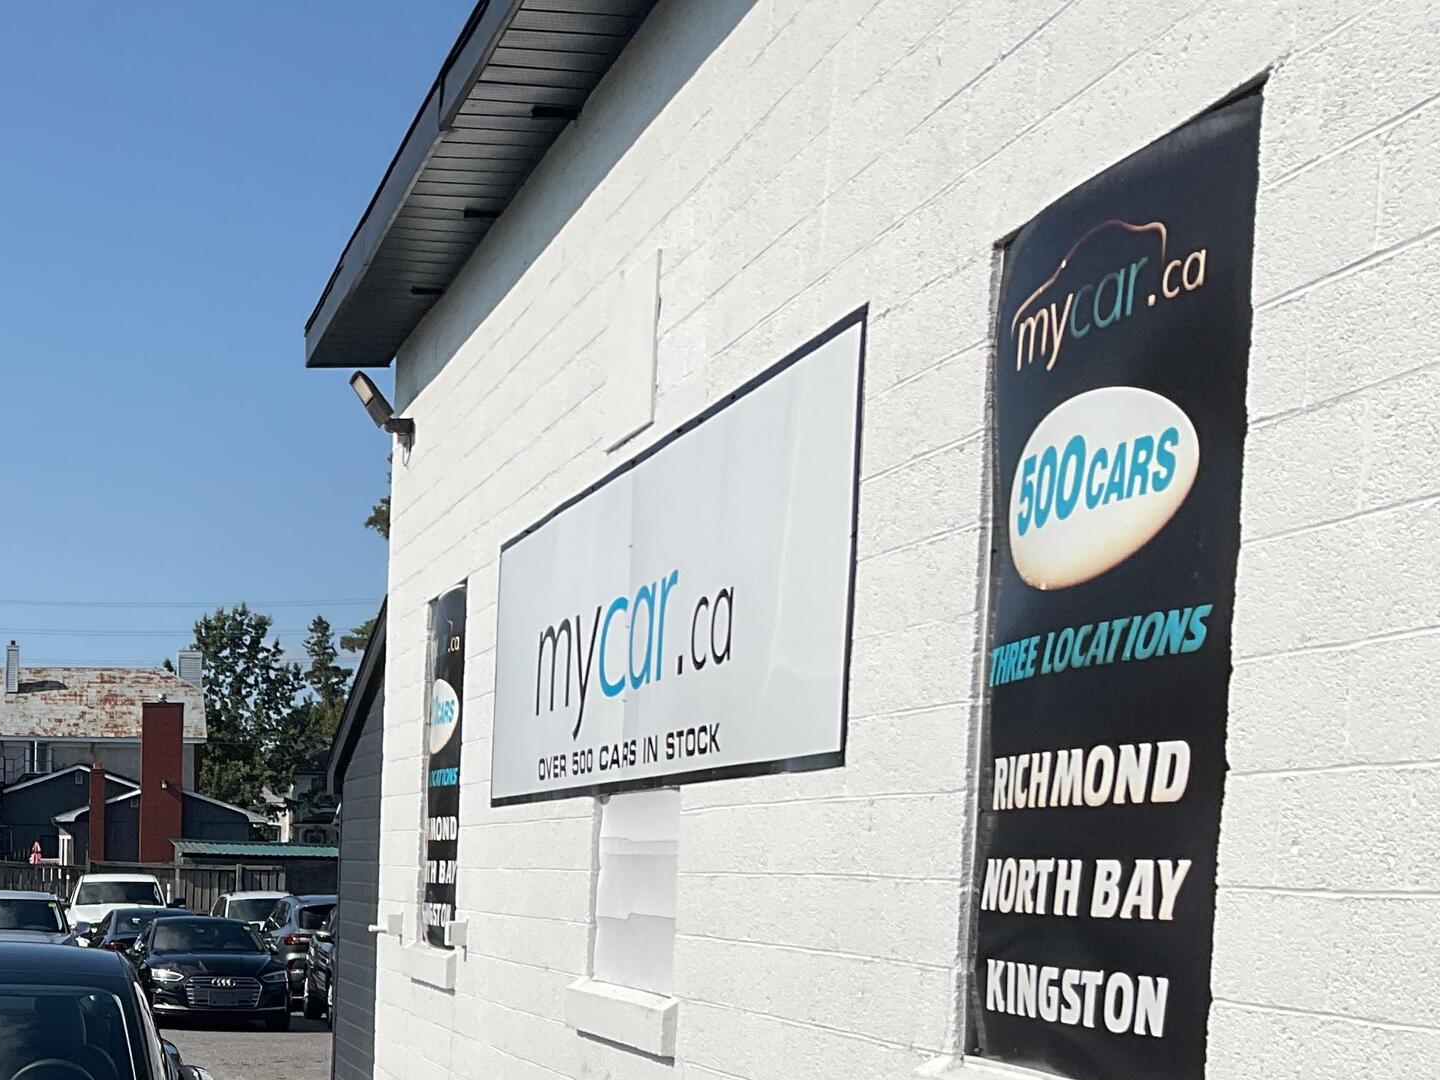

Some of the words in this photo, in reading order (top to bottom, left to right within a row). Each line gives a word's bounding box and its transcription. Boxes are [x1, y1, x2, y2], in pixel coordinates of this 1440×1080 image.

[1016, 248, 1207, 371] mycar.ca
[535, 569, 734, 741] mycar.ca
[989, 635, 1040, 687] THREE
[1041, 604, 1213, 675] LOCATIONS
[538, 754, 567, 781] OVER
[572, 748, 593, 776] 500
[599, 739, 637, 771] CARS
[643, 735, 658, 764] IN
[665, 722, 720, 760] STOCK
[992, 740, 1191, 811] RICHMOND
[981, 857, 1082, 916] NORTH
[1090, 858, 1192, 920] BAY
[986, 958, 1169, 1038] KINGSTON
